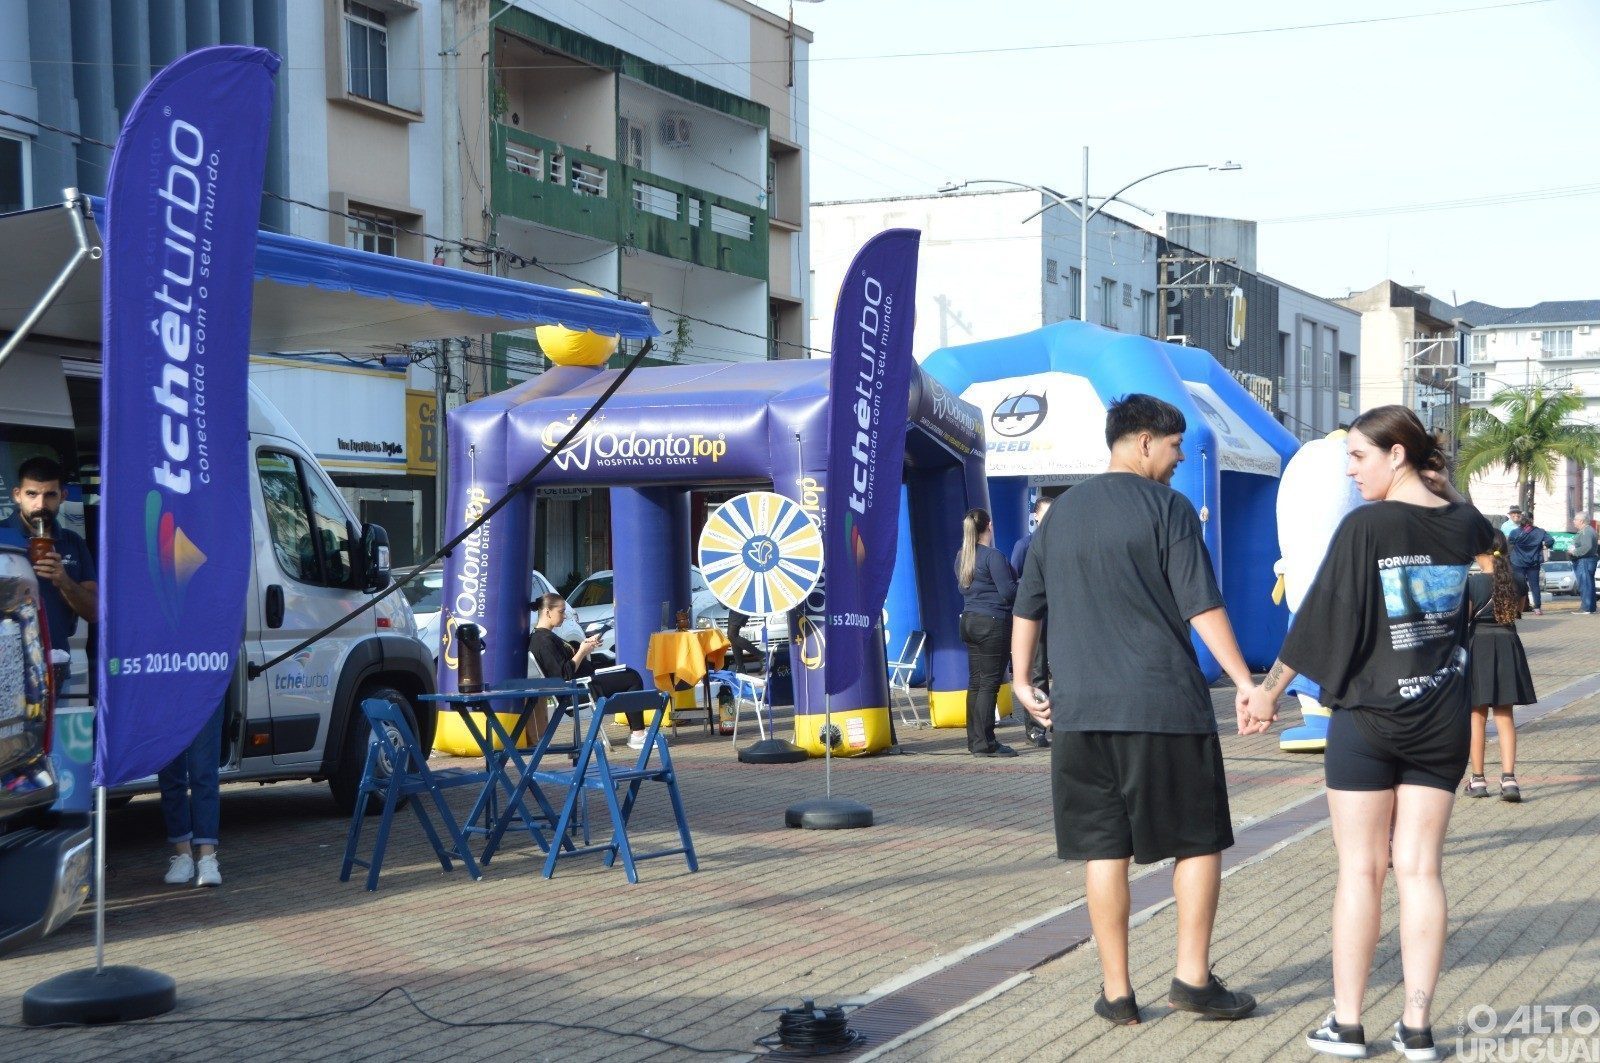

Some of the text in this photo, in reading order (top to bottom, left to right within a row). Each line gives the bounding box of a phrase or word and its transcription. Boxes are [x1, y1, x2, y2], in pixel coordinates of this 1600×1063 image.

[151, 119, 204, 495] tchêturbo
[192, 149, 221, 484] conectada com o seu mundo.
[849, 276, 883, 515] tchêturbo
[867, 430, 879, 508] conectada
[873, 395, 881, 425] com
[877, 351, 887, 376] seu
[594, 430, 727, 463] OdontoTop
[597, 457, 698, 467] HOSPITAL DO DENTE
[477, 518, 491, 618] HOSPITAL DO DENTE
[1378, 555, 1431, 569] FORWARDS
[833, 613, 843, 626] 55
[121, 651, 229, 675] 55 2010-0000
[1397, 676, 1419, 687] FIGHT
